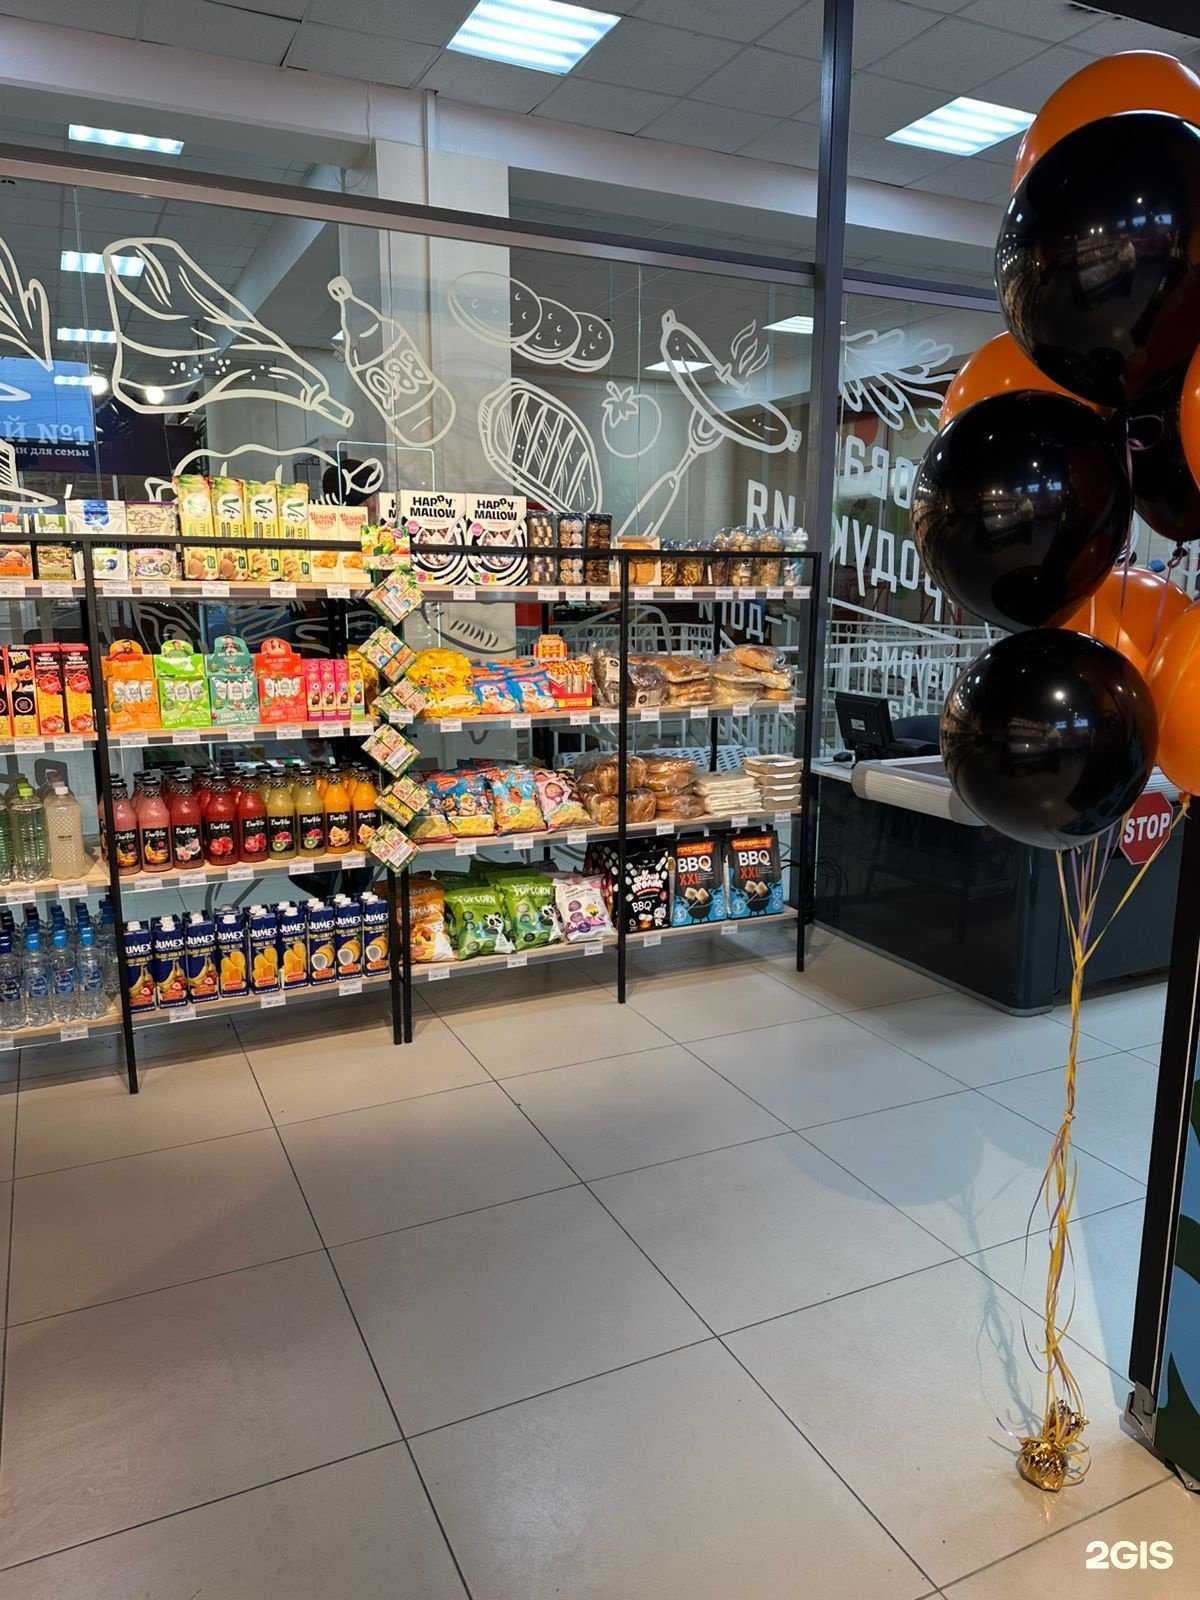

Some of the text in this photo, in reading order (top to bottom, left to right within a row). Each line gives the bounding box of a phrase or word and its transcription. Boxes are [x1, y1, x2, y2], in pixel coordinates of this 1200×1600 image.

[54, 448, 90, 457] семьи
[413, 495, 453, 508] HAPPY
[477, 498, 515, 511] HAPPY
[410, 507, 456, 519] MALLOW
[474, 510, 518, 521] MALLOW
[1124, 813, 1170, 843] STOP
[738, 850, 771, 866] BBQ
[678, 855, 712, 873] BBQ
[632, 901, 652, 913] BBQ
[336, 916, 361, 925] JUMEX
[364, 912, 389, 921] JUMEX
[309, 920, 335, 929] JUMEX
[218, 930, 244, 940] JUMEX
[251, 928, 277, 937] JUMEX
[155, 938, 185, 948] JUMEX
[187, 935, 215, 945] JUMEX
[126, 943, 152, 954] UMEX
